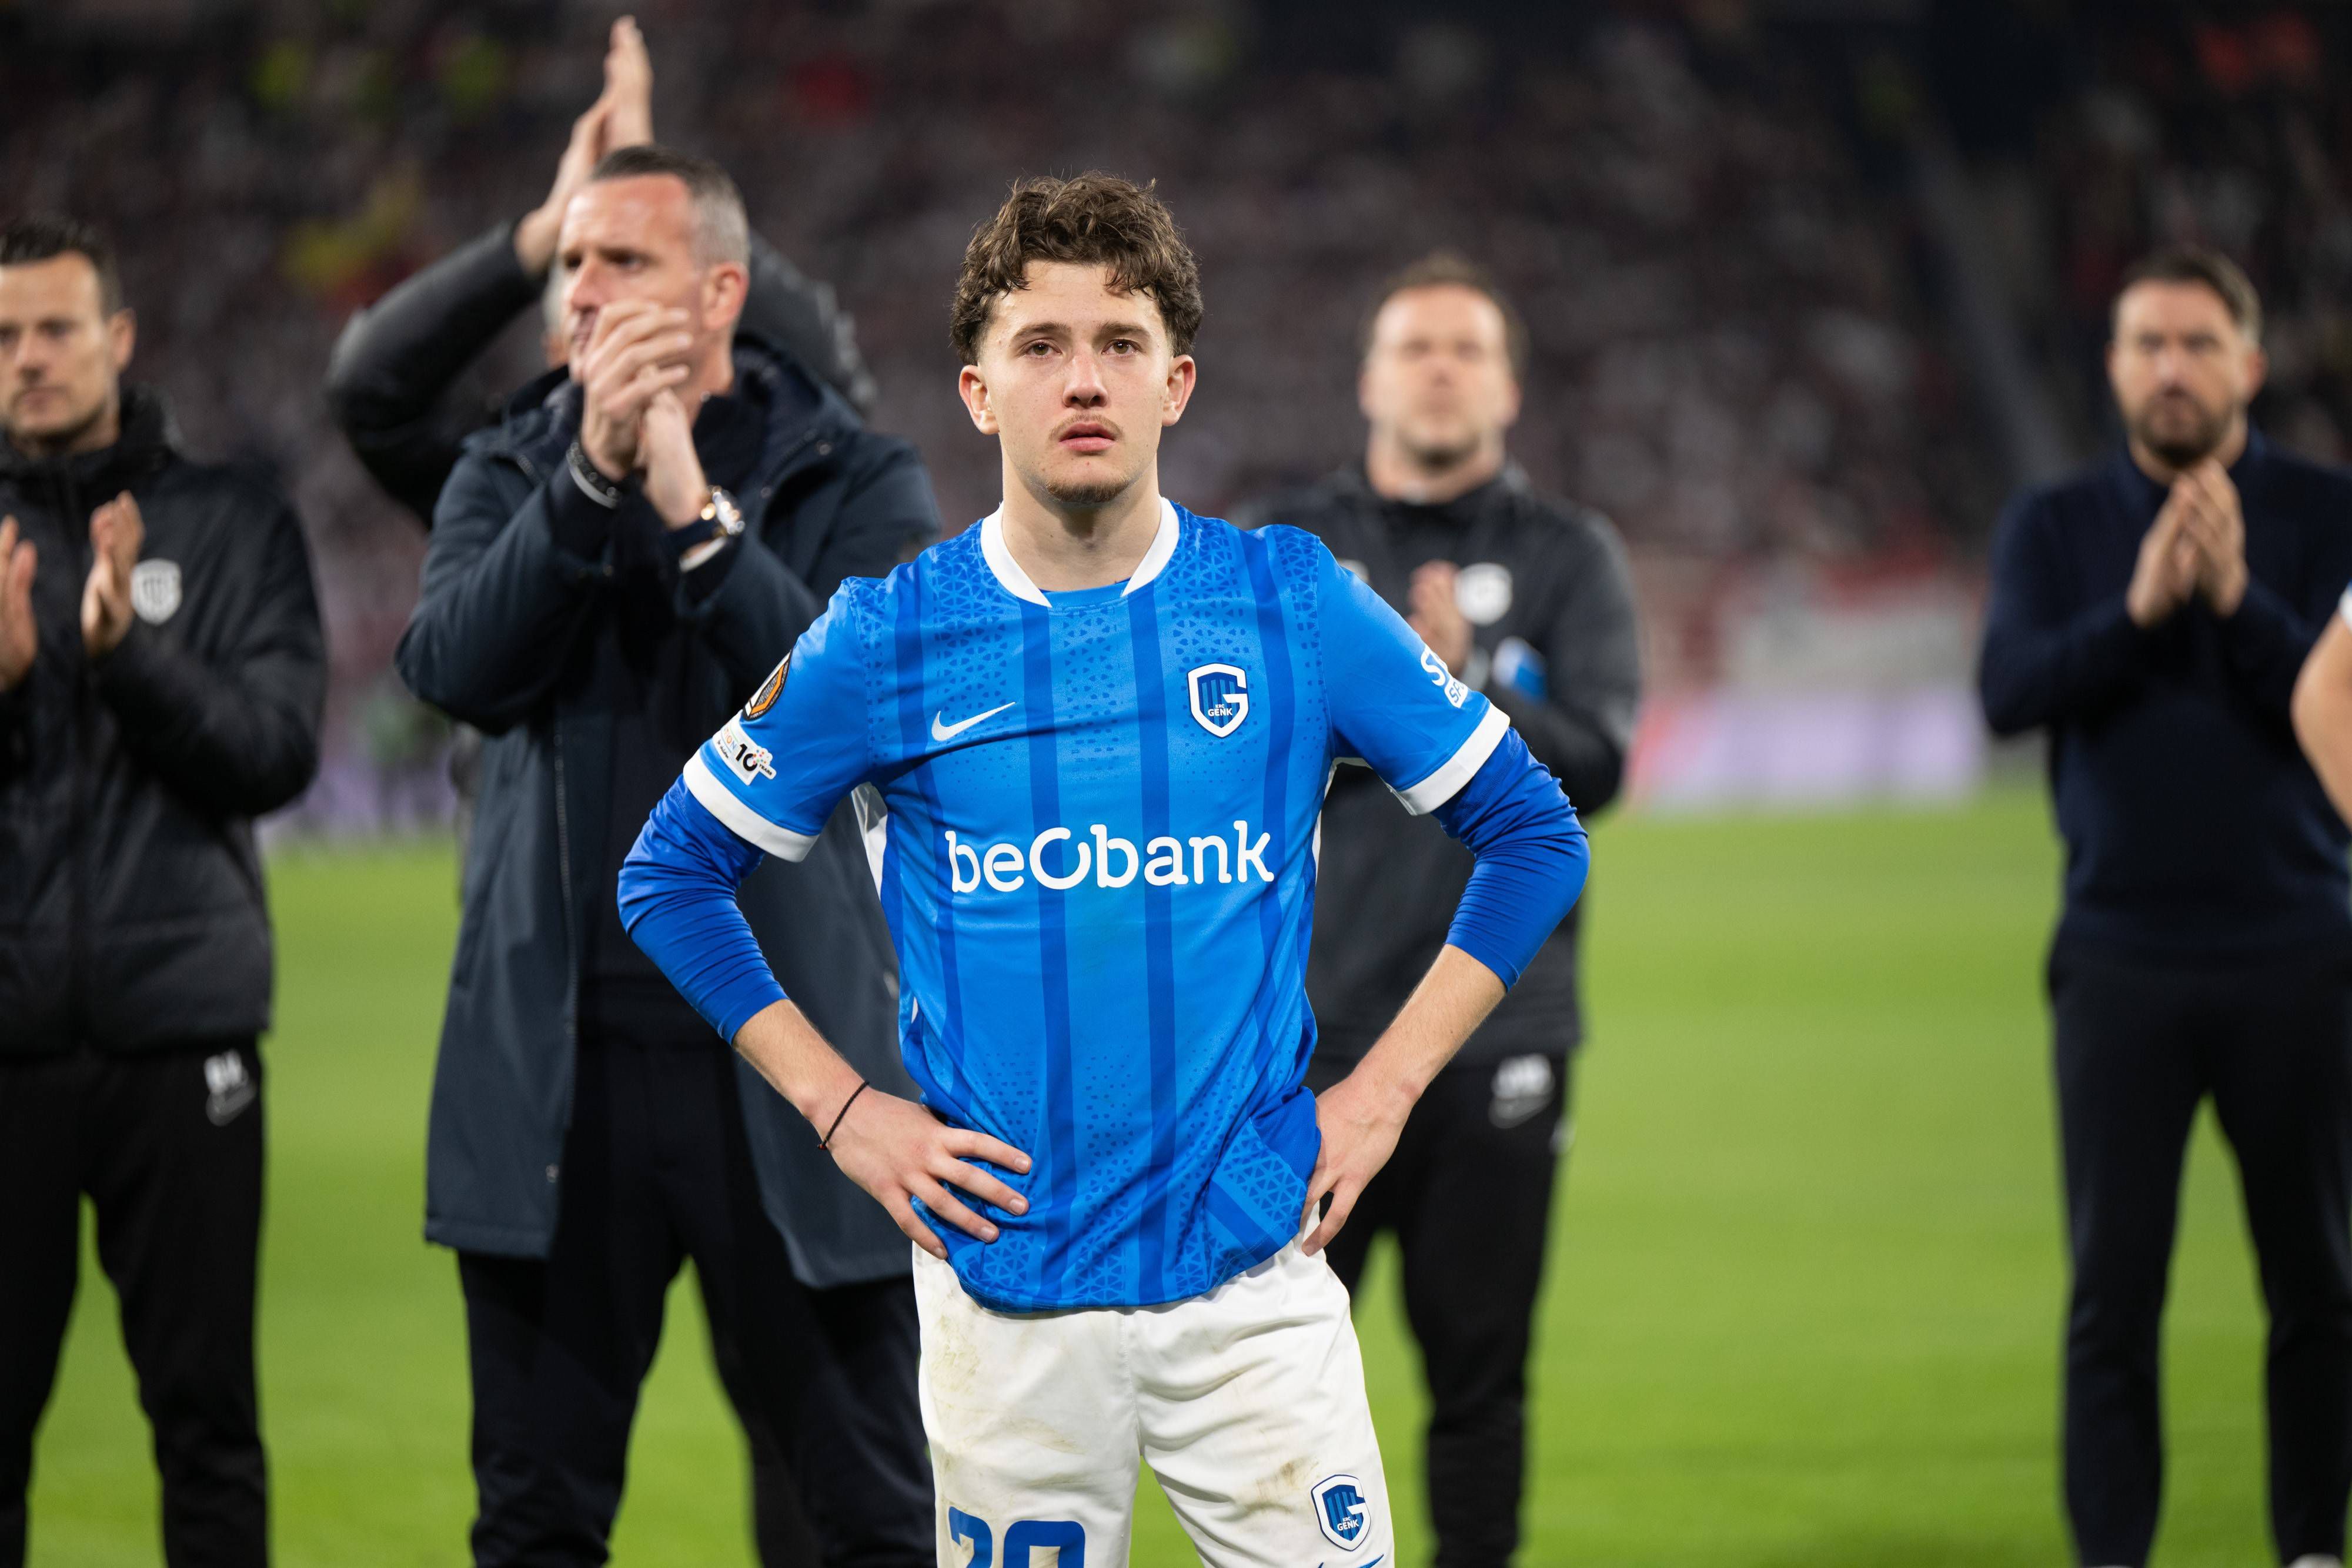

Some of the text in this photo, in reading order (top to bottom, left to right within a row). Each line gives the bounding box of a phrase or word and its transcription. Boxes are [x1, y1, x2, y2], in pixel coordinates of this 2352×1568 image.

[1208, 708, 1232, 717] GENK
[736, 743, 758, 771] 10
[759, 764, 773, 775] YEARS
[1337, 1519, 1359, 1531] GENK
